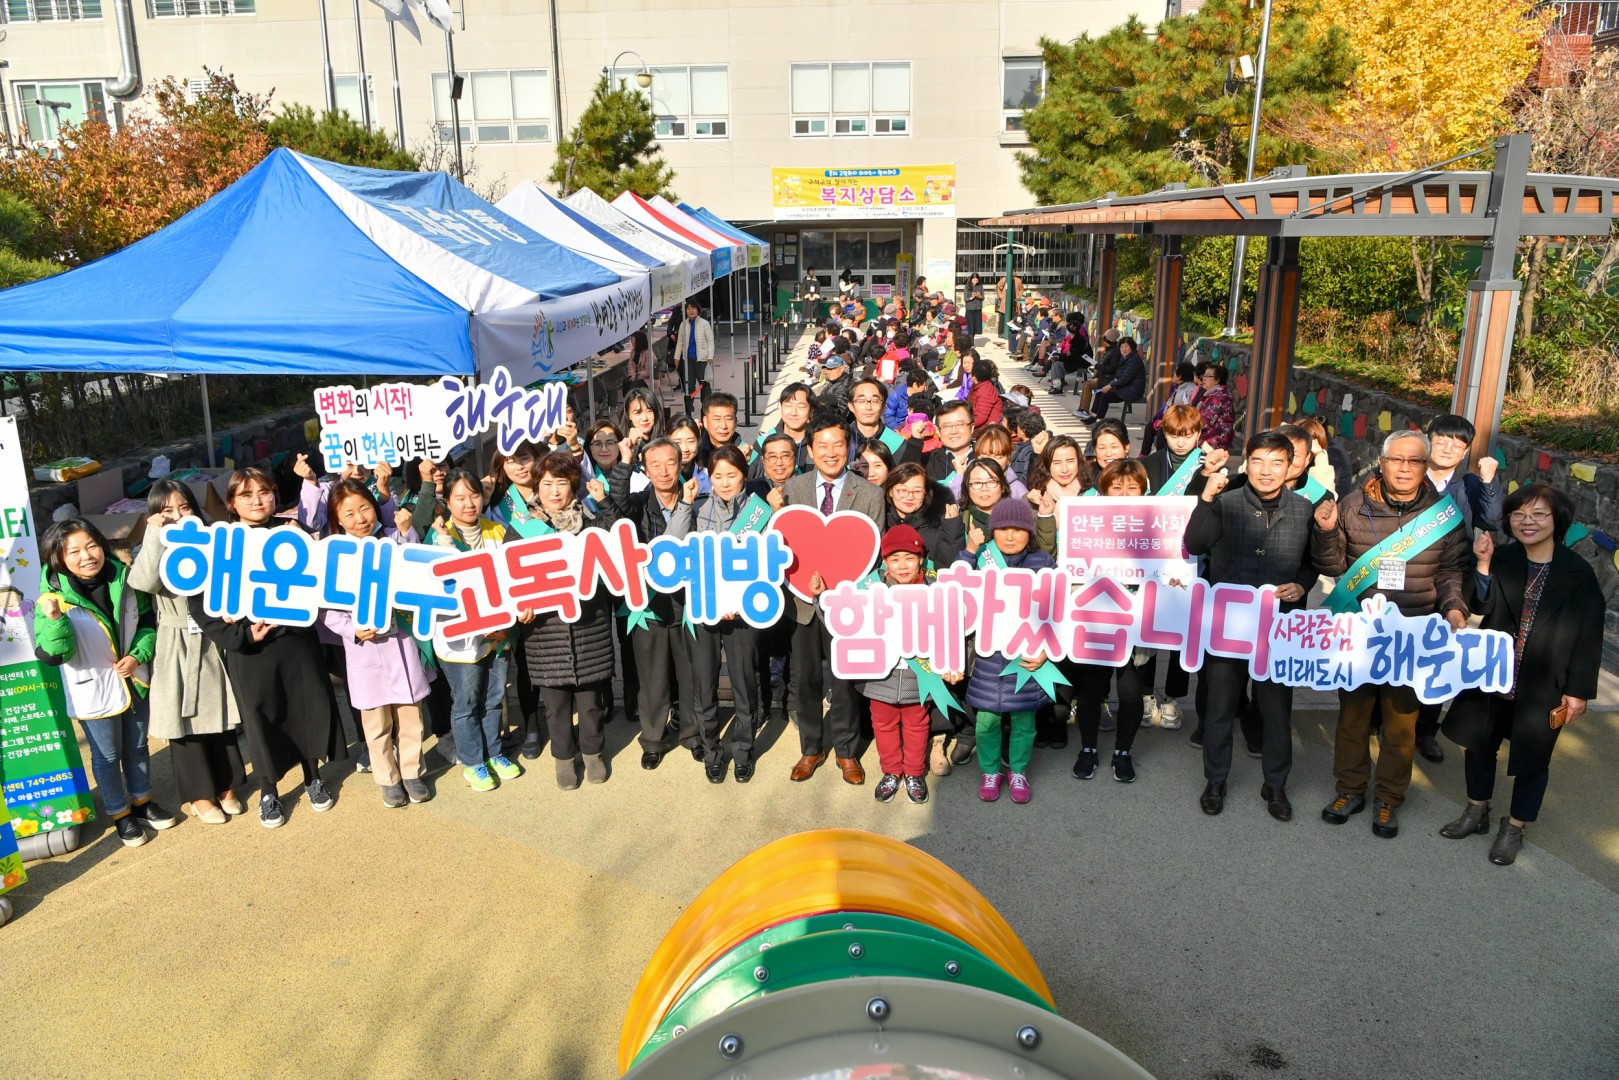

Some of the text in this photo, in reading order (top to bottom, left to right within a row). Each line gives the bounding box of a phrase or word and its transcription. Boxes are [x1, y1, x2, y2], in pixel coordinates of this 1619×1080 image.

[808, 178, 832, 186] 구석구석
[834, 178, 859, 186] 찾아가는
[820, 187, 916, 205] 복지상담소
[319, 387, 413, 425] 변화의 시작!
[443, 371, 563, 453] 해운대
[324, 431, 441, 468] 꿈이 현실이 되는
[1071, 514, 1185, 532] 안부 묻는 사회
[1414, 504, 1456, 539] 반여2동
[1066, 564, 1085, 576] Re
[432, 523, 650, 638] 고독사
[647, 533, 788, 623] 예방
[1274, 614, 1354, 651] 사람중심
[1366, 617, 1507, 699] 해운대
[26, 669, 38, 678] 1층
[1274, 656, 1353, 686] 미래도시
[4, 702, 37, 716] 건강상담
[20, 711, 47, 722] 스트레스
[25, 733, 42, 744] 안내
[42, 732, 51, 741] 및
[26, 772, 74, 788] 749-6853
[18, 786, 64, 801] 마을건강센터
